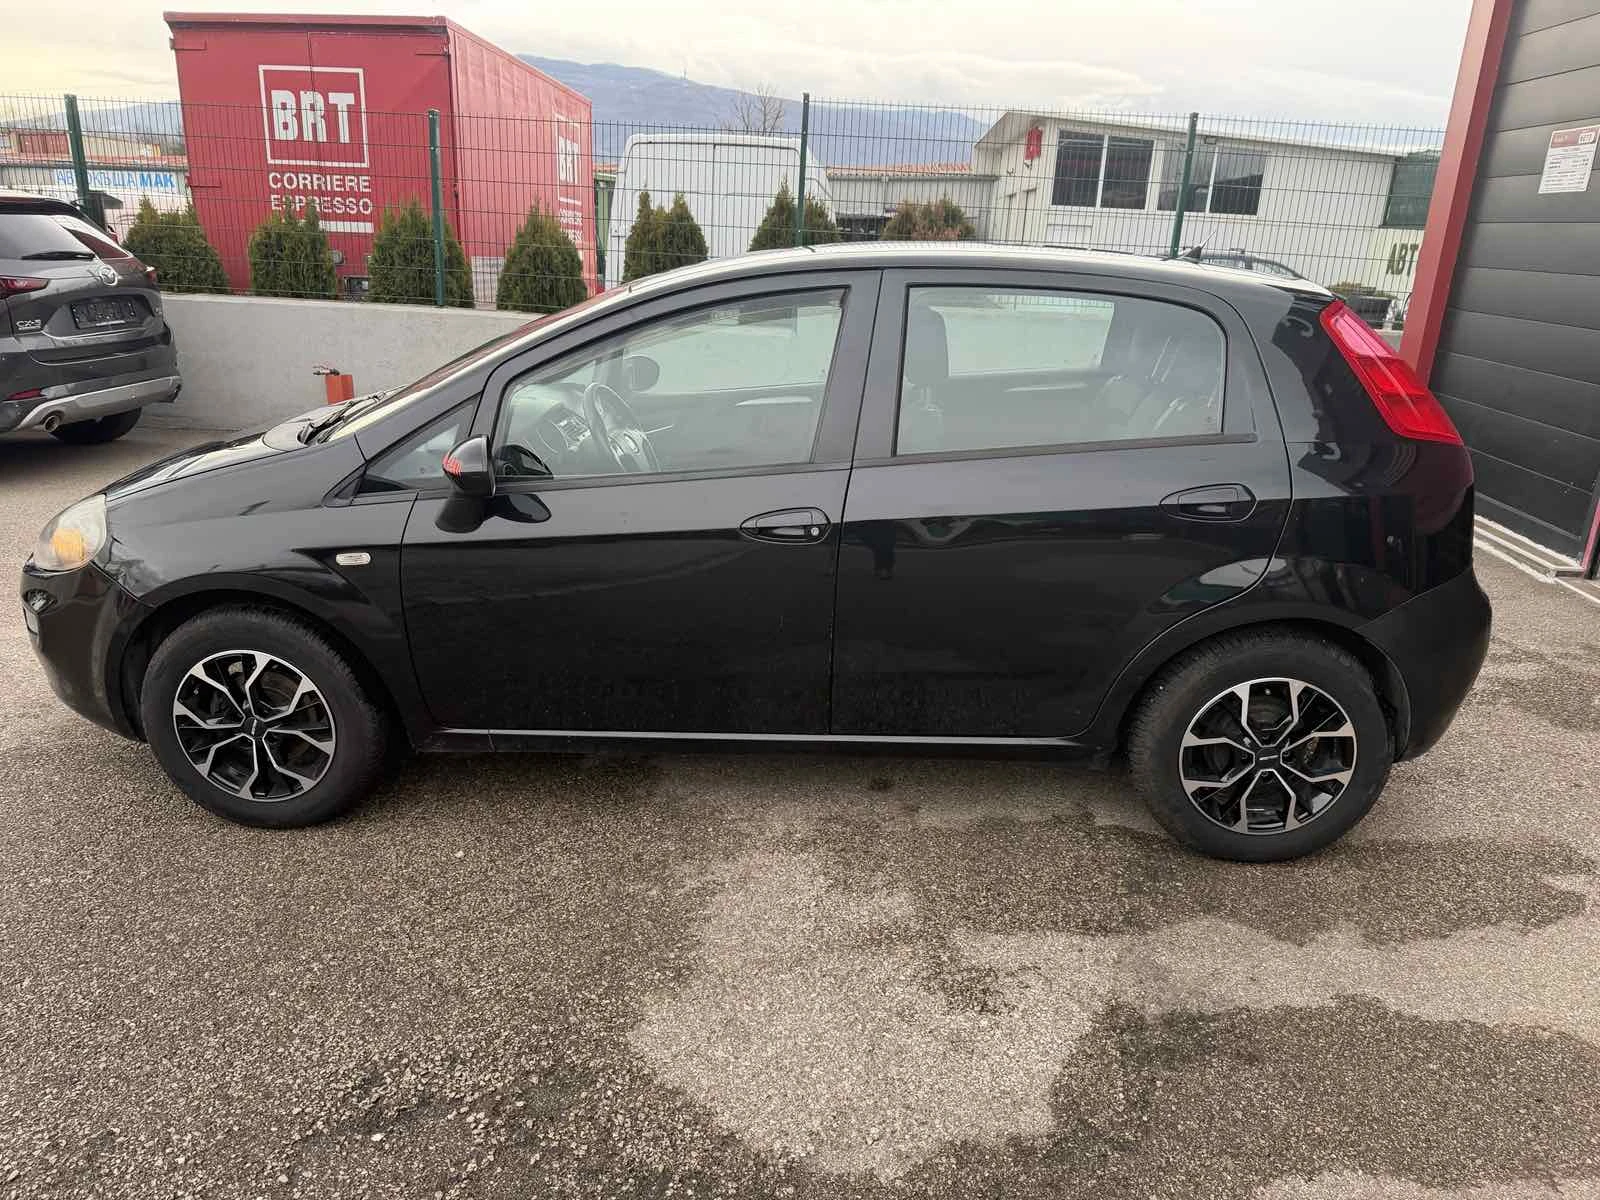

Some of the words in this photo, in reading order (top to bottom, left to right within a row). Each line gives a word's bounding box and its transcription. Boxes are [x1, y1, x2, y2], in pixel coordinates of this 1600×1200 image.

[271, 89, 355, 144] BRT
[268, 171, 372, 192] CORRIERE
[559, 136, 579, 185] BRT
